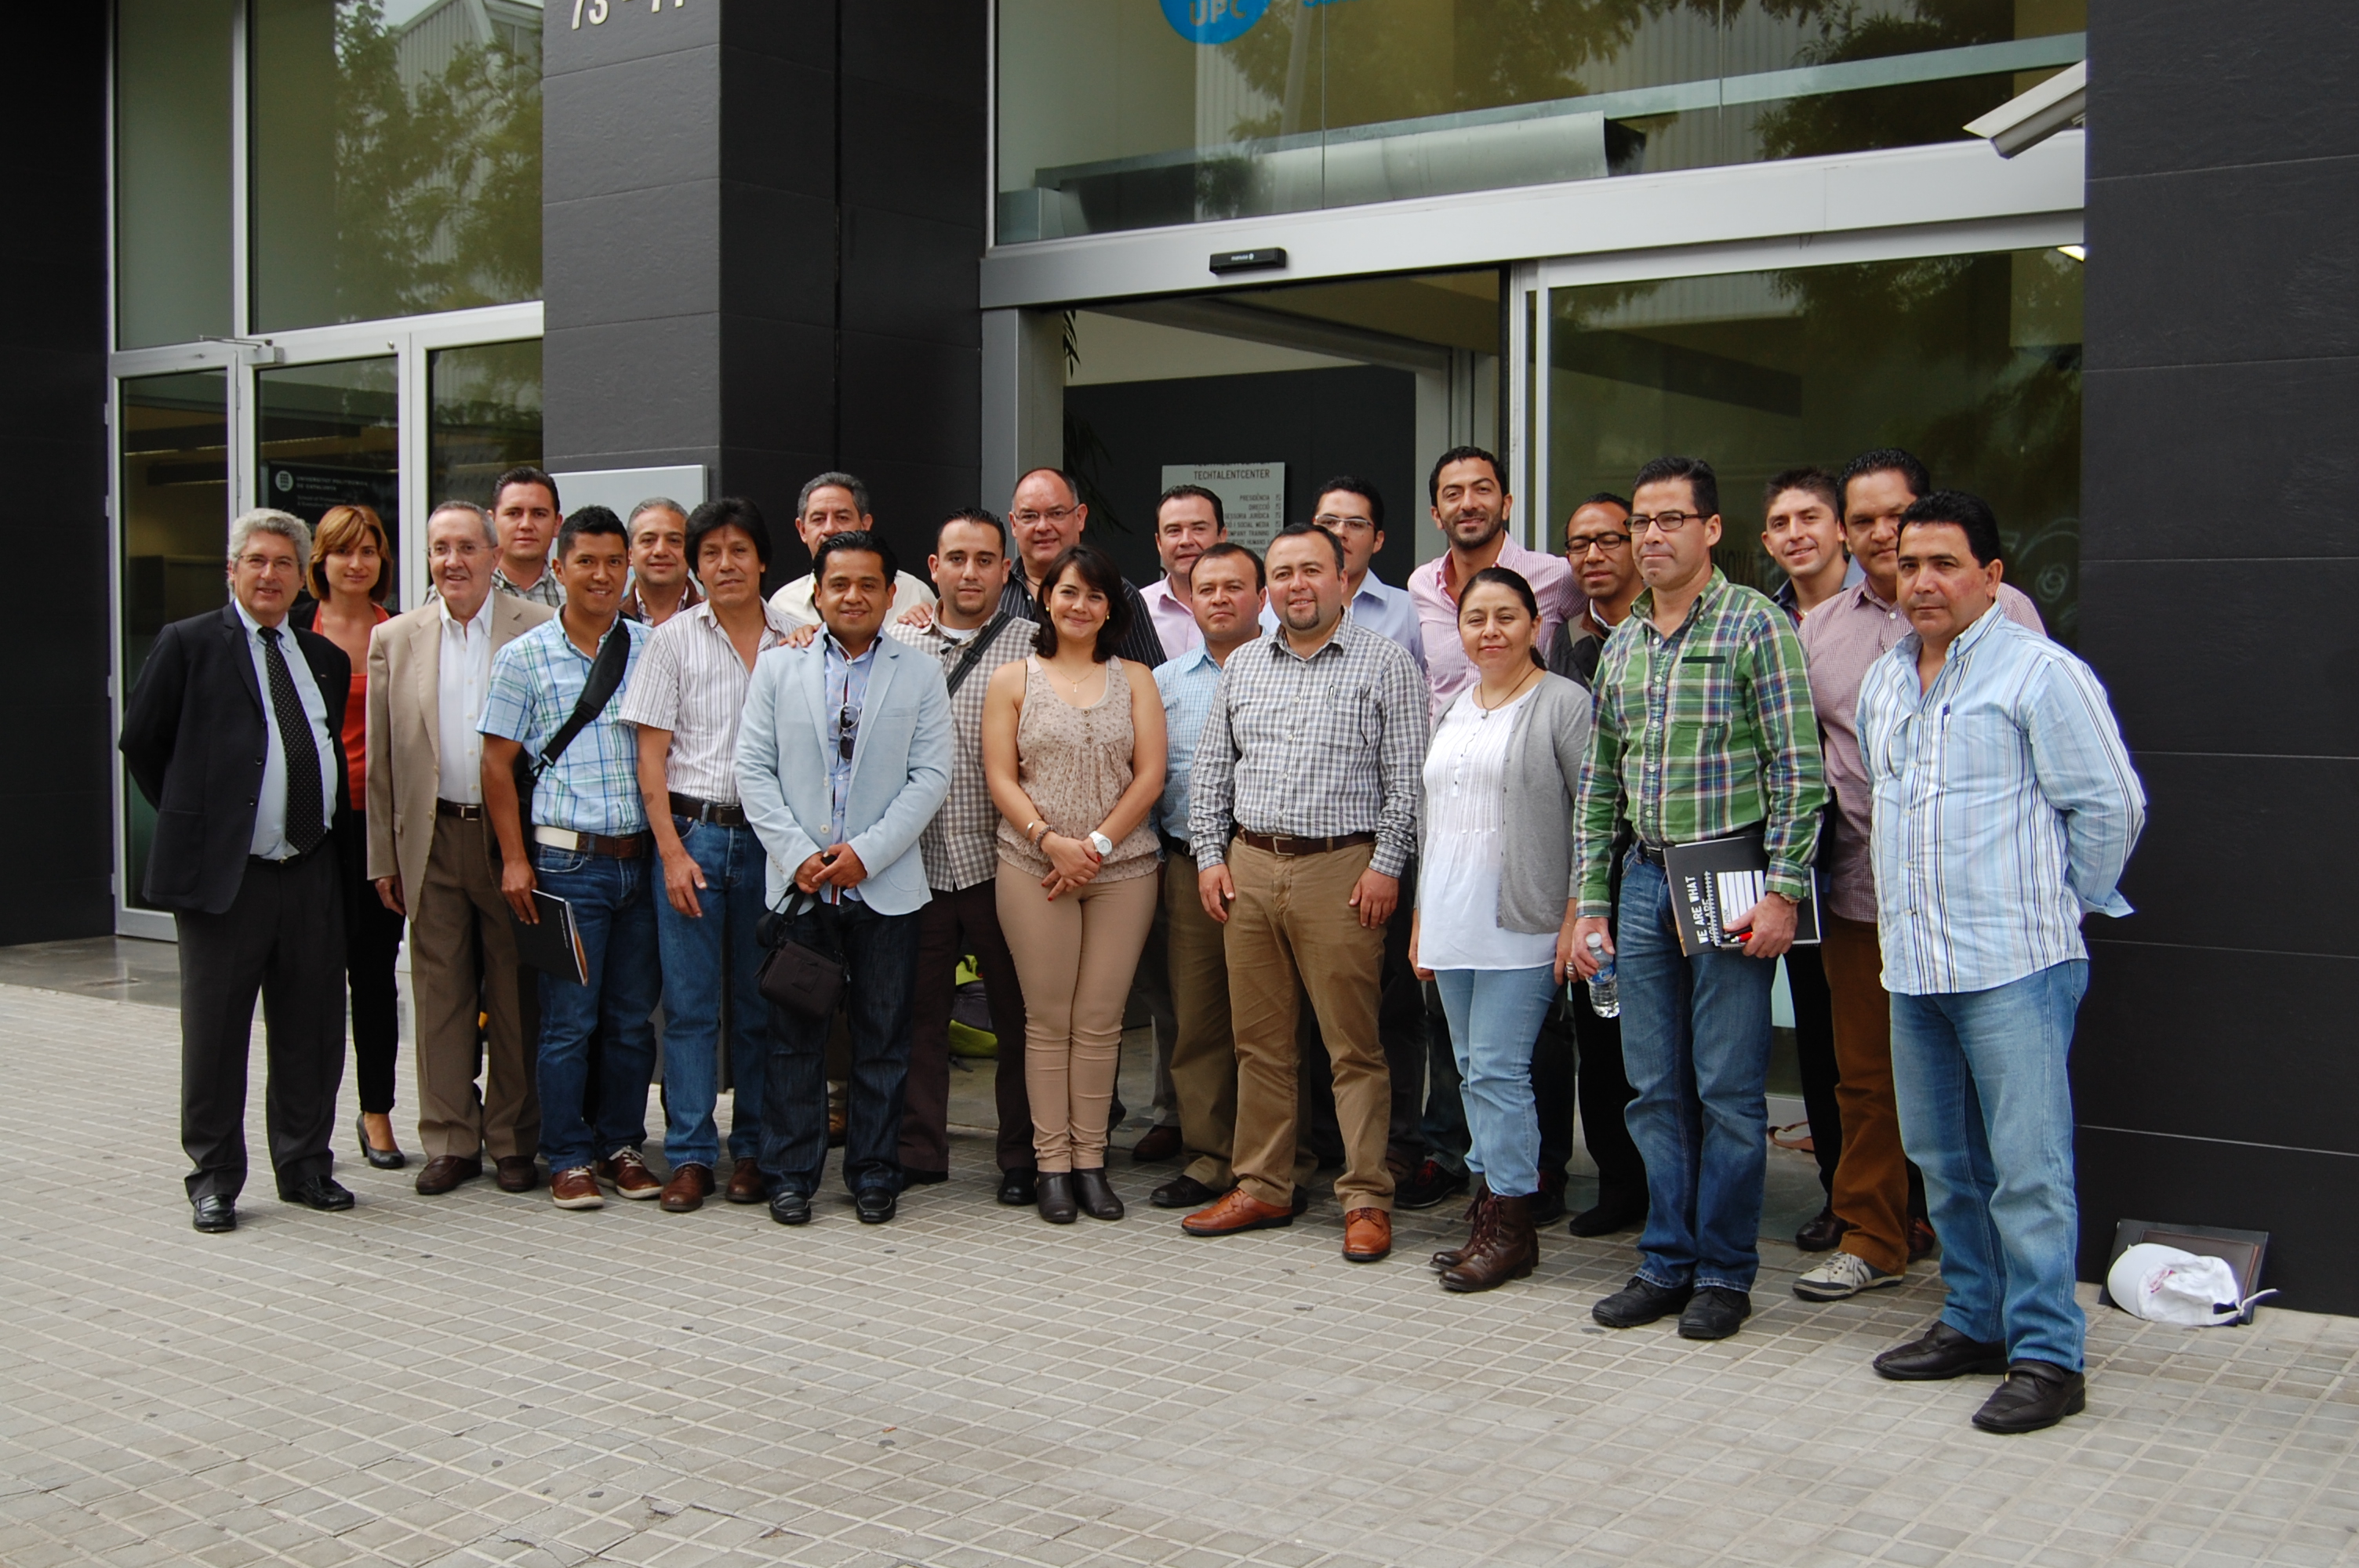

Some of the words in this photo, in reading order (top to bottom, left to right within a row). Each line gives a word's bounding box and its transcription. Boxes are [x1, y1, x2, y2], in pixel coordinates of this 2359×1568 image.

[1190, 0, 1245, 26] UPC
[1194, 469, 1270, 480] TECHTALENTCENTER
[1685, 876, 1700, 903] WHAT
[1691, 906, 1705, 925] ARE
[1696, 929, 1709, 944] WE
